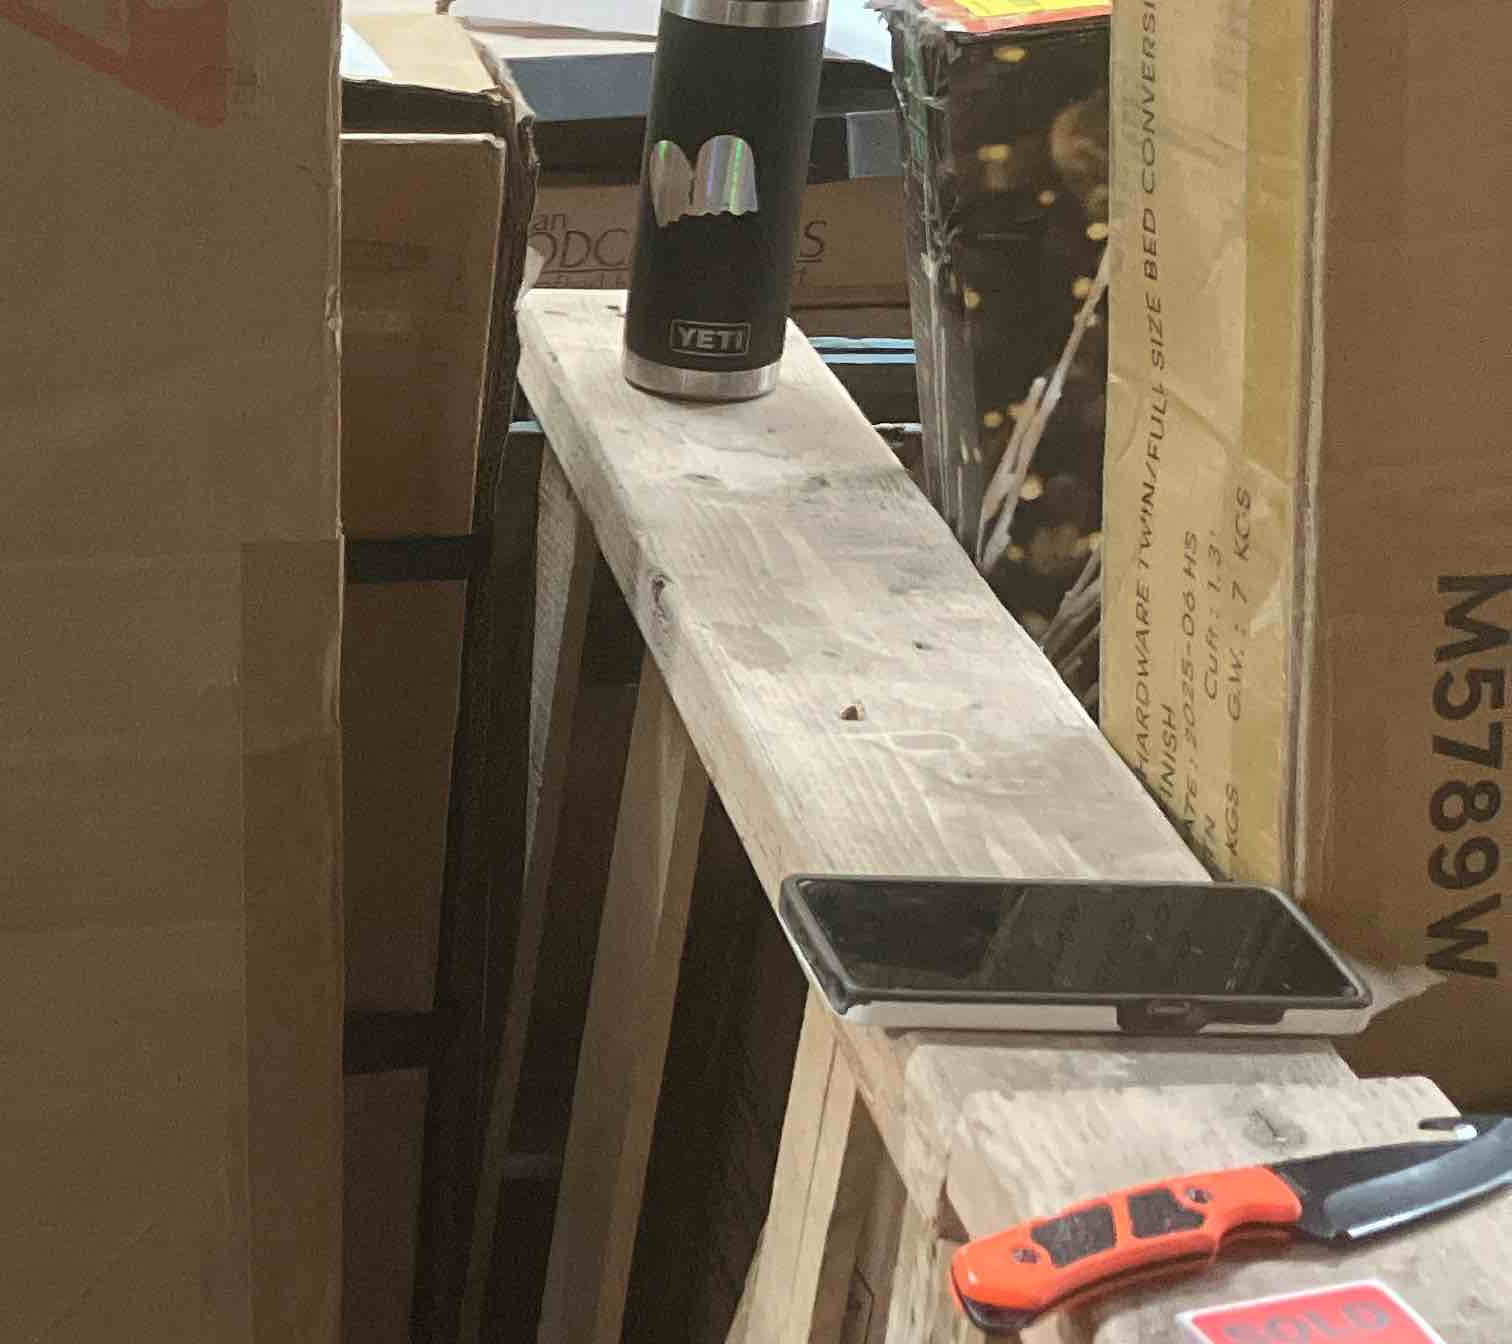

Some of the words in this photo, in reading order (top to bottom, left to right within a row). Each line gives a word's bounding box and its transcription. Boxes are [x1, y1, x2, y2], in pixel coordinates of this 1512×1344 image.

[1142, 207, 1159, 282] BED
[677, 326, 744, 352] YETI
[1144, 293, 1166, 371] SIZE
[1137, 382, 1168, 569] TWIN/FULL
[1182, 531, 1198, 579] HS
[1231, 580, 1248, 604] 7
[1133, 579, 1152, 780] HARDWARE
[1181, 591, 1197, 749] 2025-06
[1160, 703, 1177, 799] INISH
[1425, 573, 1512, 980] M5789W
[1225, 783, 1239, 857] KGS
